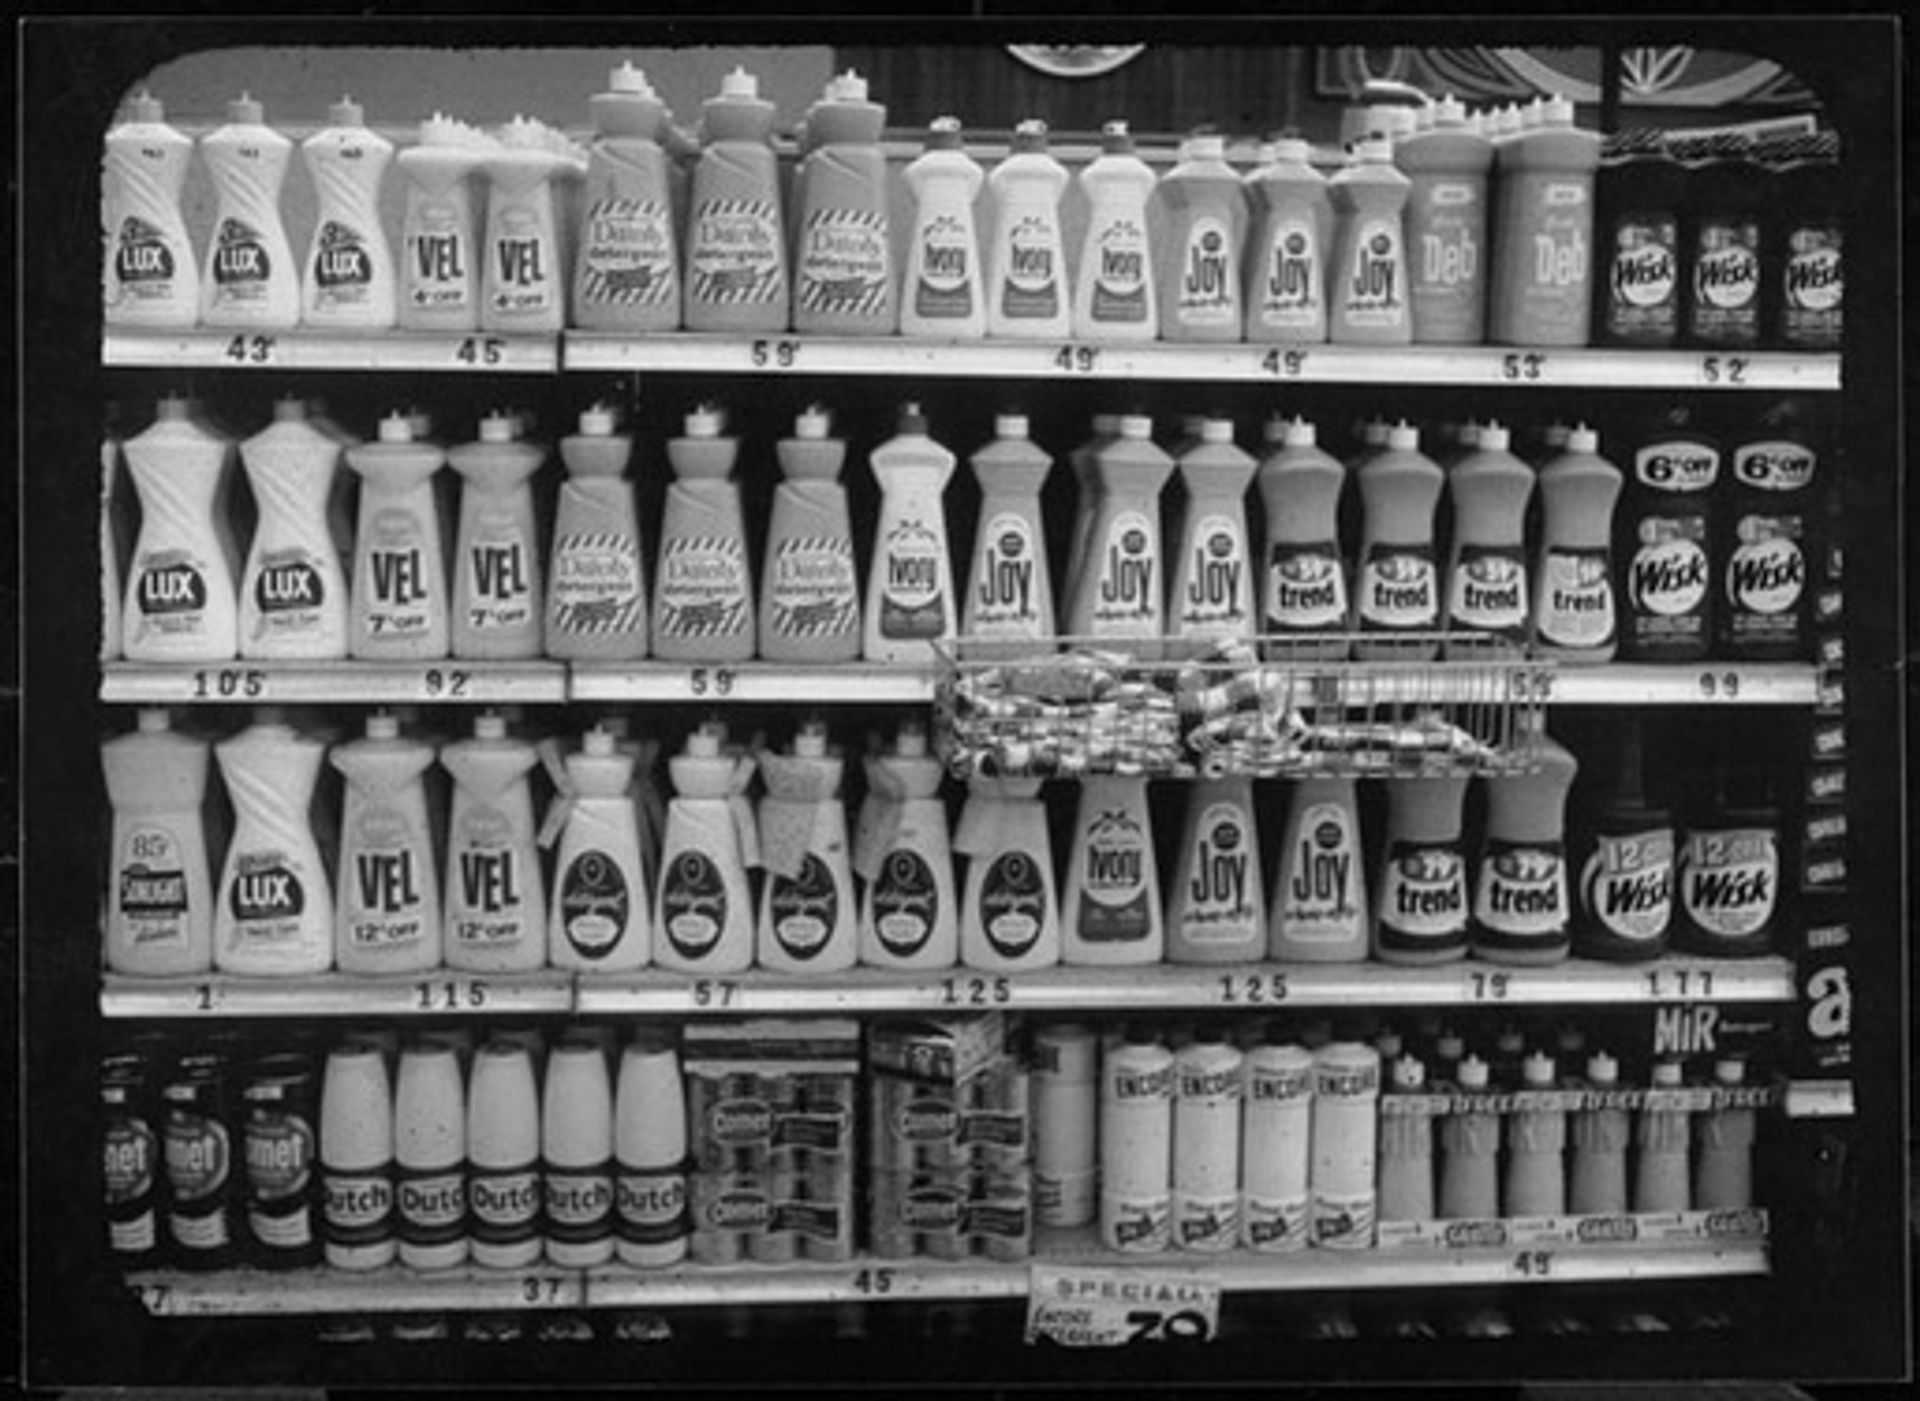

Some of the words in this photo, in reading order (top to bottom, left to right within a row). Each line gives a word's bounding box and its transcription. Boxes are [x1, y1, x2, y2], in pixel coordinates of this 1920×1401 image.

[121, 244, 165, 272] LUX
[220, 245, 261, 275] LUX
[321, 248, 363, 278] LUX
[417, 234, 464, 282] VEL
[497, 238, 544, 287] VEL
[1185, 246, 1228, 302] Joy
[1269, 246, 1314, 306] Joy
[1351, 245, 1397, 306] Joy
[1423, 228, 1477, 286] Deb
[1535, 228, 1587, 286] Deb
[145, 570, 195, 602] LUX
[264, 568, 313, 600] LUX
[371, 549, 427, 606] VEL
[471, 543, 529, 600] VEL
[979, 548, 1033, 617] Joy
[1101, 546, 1154, 617] Joy
[1188, 548, 1242, 617] Joy
[1279, 580, 1337, 610] trend
[1373, 580, 1430, 610] trend
[1464, 580, 1519, 610] trend
[1635, 552, 1705, 595] Wisk
[1732, 551, 1803, 593] Wisk
[238, 875, 291, 908] LUX
[358, 848, 420, 914] VEL
[460, 849, 521, 914] VEL
[1191, 840, 1248, 913] Joy
[1292, 840, 1351, 913] Joy
[1396, 880, 1461, 915] trend
[1490, 880, 1560, 915] trend
[1692, 869, 1769, 910] Wisk
